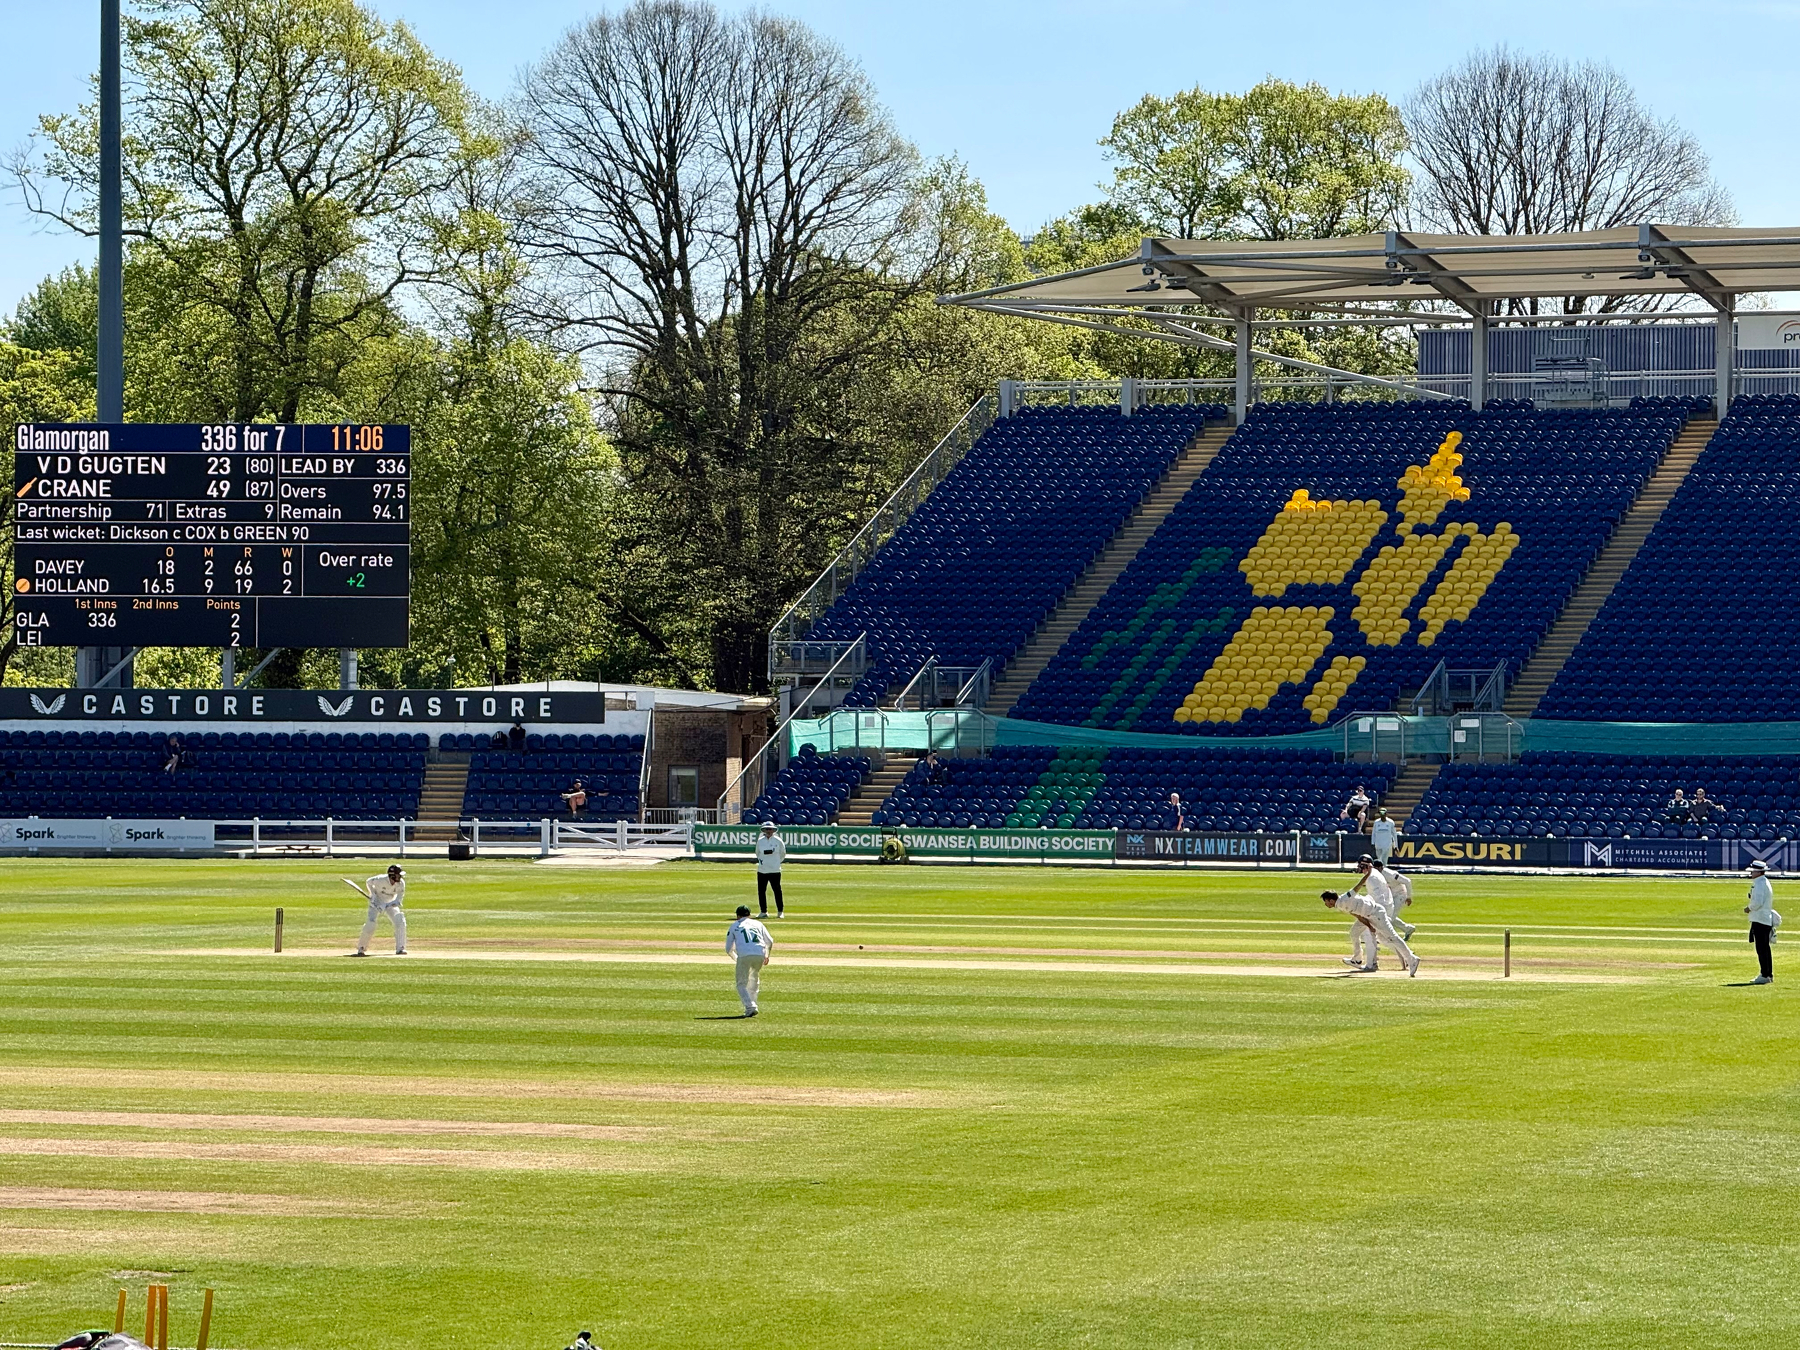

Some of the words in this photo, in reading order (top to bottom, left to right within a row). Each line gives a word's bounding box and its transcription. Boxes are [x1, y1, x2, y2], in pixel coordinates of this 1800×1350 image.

[1784, 333, 1800, 343] pr
[17, 425, 110, 452] Glamorgan
[202, 426, 236, 451] 336
[243, 426, 268, 451] for
[275, 426, 285, 451] 7
[332, 426, 382, 451] 11:06
[38, 456, 50, 473] V
[58, 457, 71, 473] D
[79, 457, 165, 474] GUGTEN
[208, 457, 230, 474] 23
[246, 457, 273, 474] (80)
[282, 459, 326, 473] LEAD
[333, 459, 354, 473] BY
[377, 459, 405, 473] 336
[39, 480, 111, 497] CRANE
[207, 481, 230, 497] 49
[246, 480, 273, 497] (87)
[281, 484, 326, 498] Overs
[373, 484, 405, 498] 97.5
[17, 503, 112, 520] Partnership
[147, 504, 162, 518] 71
[177, 504, 226, 518] Extras
[265, 504, 273, 518] 9
[282, 504, 341, 519] Remain
[373, 505, 403, 519] 94.1
[18, 525, 48, 538] Last
[53, 525, 104, 539] wicket:
[111, 526, 168, 539] Dickson
[173, 530, 180, 539] c
[186, 526, 215, 539] COX
[221, 527, 229, 539] b
[234, 526, 286, 539] GREEN
[292, 527, 308, 540] 90
[166, 547, 173, 556] O
[205, 547, 213, 557] M
[245, 547, 251, 557] R
[282, 548, 292, 557] W
[320, 552, 356, 566] Over
[362, 554, 393, 566] rate
[36, 560, 84, 574] DAVEY
[158, 560, 174, 574] 18
[205, 561, 213, 574] 2
[235, 561, 252, 575] 66
[283, 561, 291, 575] 0
[36, 579, 109, 592] HOLLAND
[143, 579, 174, 593] 16.5
[205, 579, 213, 593] 9
[236, 579, 252, 593] 19
[283, 580, 291, 594] 2
[347, 573, 364, 587] +2
[76, 599, 90, 608] 1st
[95, 599, 116, 608] Inns
[133, 599, 152, 609] 2nd
[156, 599, 178, 609] Inns
[207, 599, 240, 609] Points
[17, 612, 49, 627] GLA
[89, 613, 116, 627] 336
[232, 614, 239, 627] 2
[17, 631, 41, 645] LEI
[232, 632, 239, 646] 2
[83, 695, 264, 715] CASTORE
[371, 697, 551, 717] CASTORE
[15, 827, 54, 841] Spark
[126, 827, 164, 842] Spark
[695, 832, 763, 846] SWANSE
[777, 833, 837, 846] UILDING
[1126, 833, 1145, 844] NX
[903, 835, 977, 849] SWANSEA
[980, 836, 1049, 850] BUILDING
[1051, 837, 1115, 851] SOCIETY
[1155, 837, 1296, 857] NXTEAMWEAR.COM
[1310, 837, 1329, 847] NX
